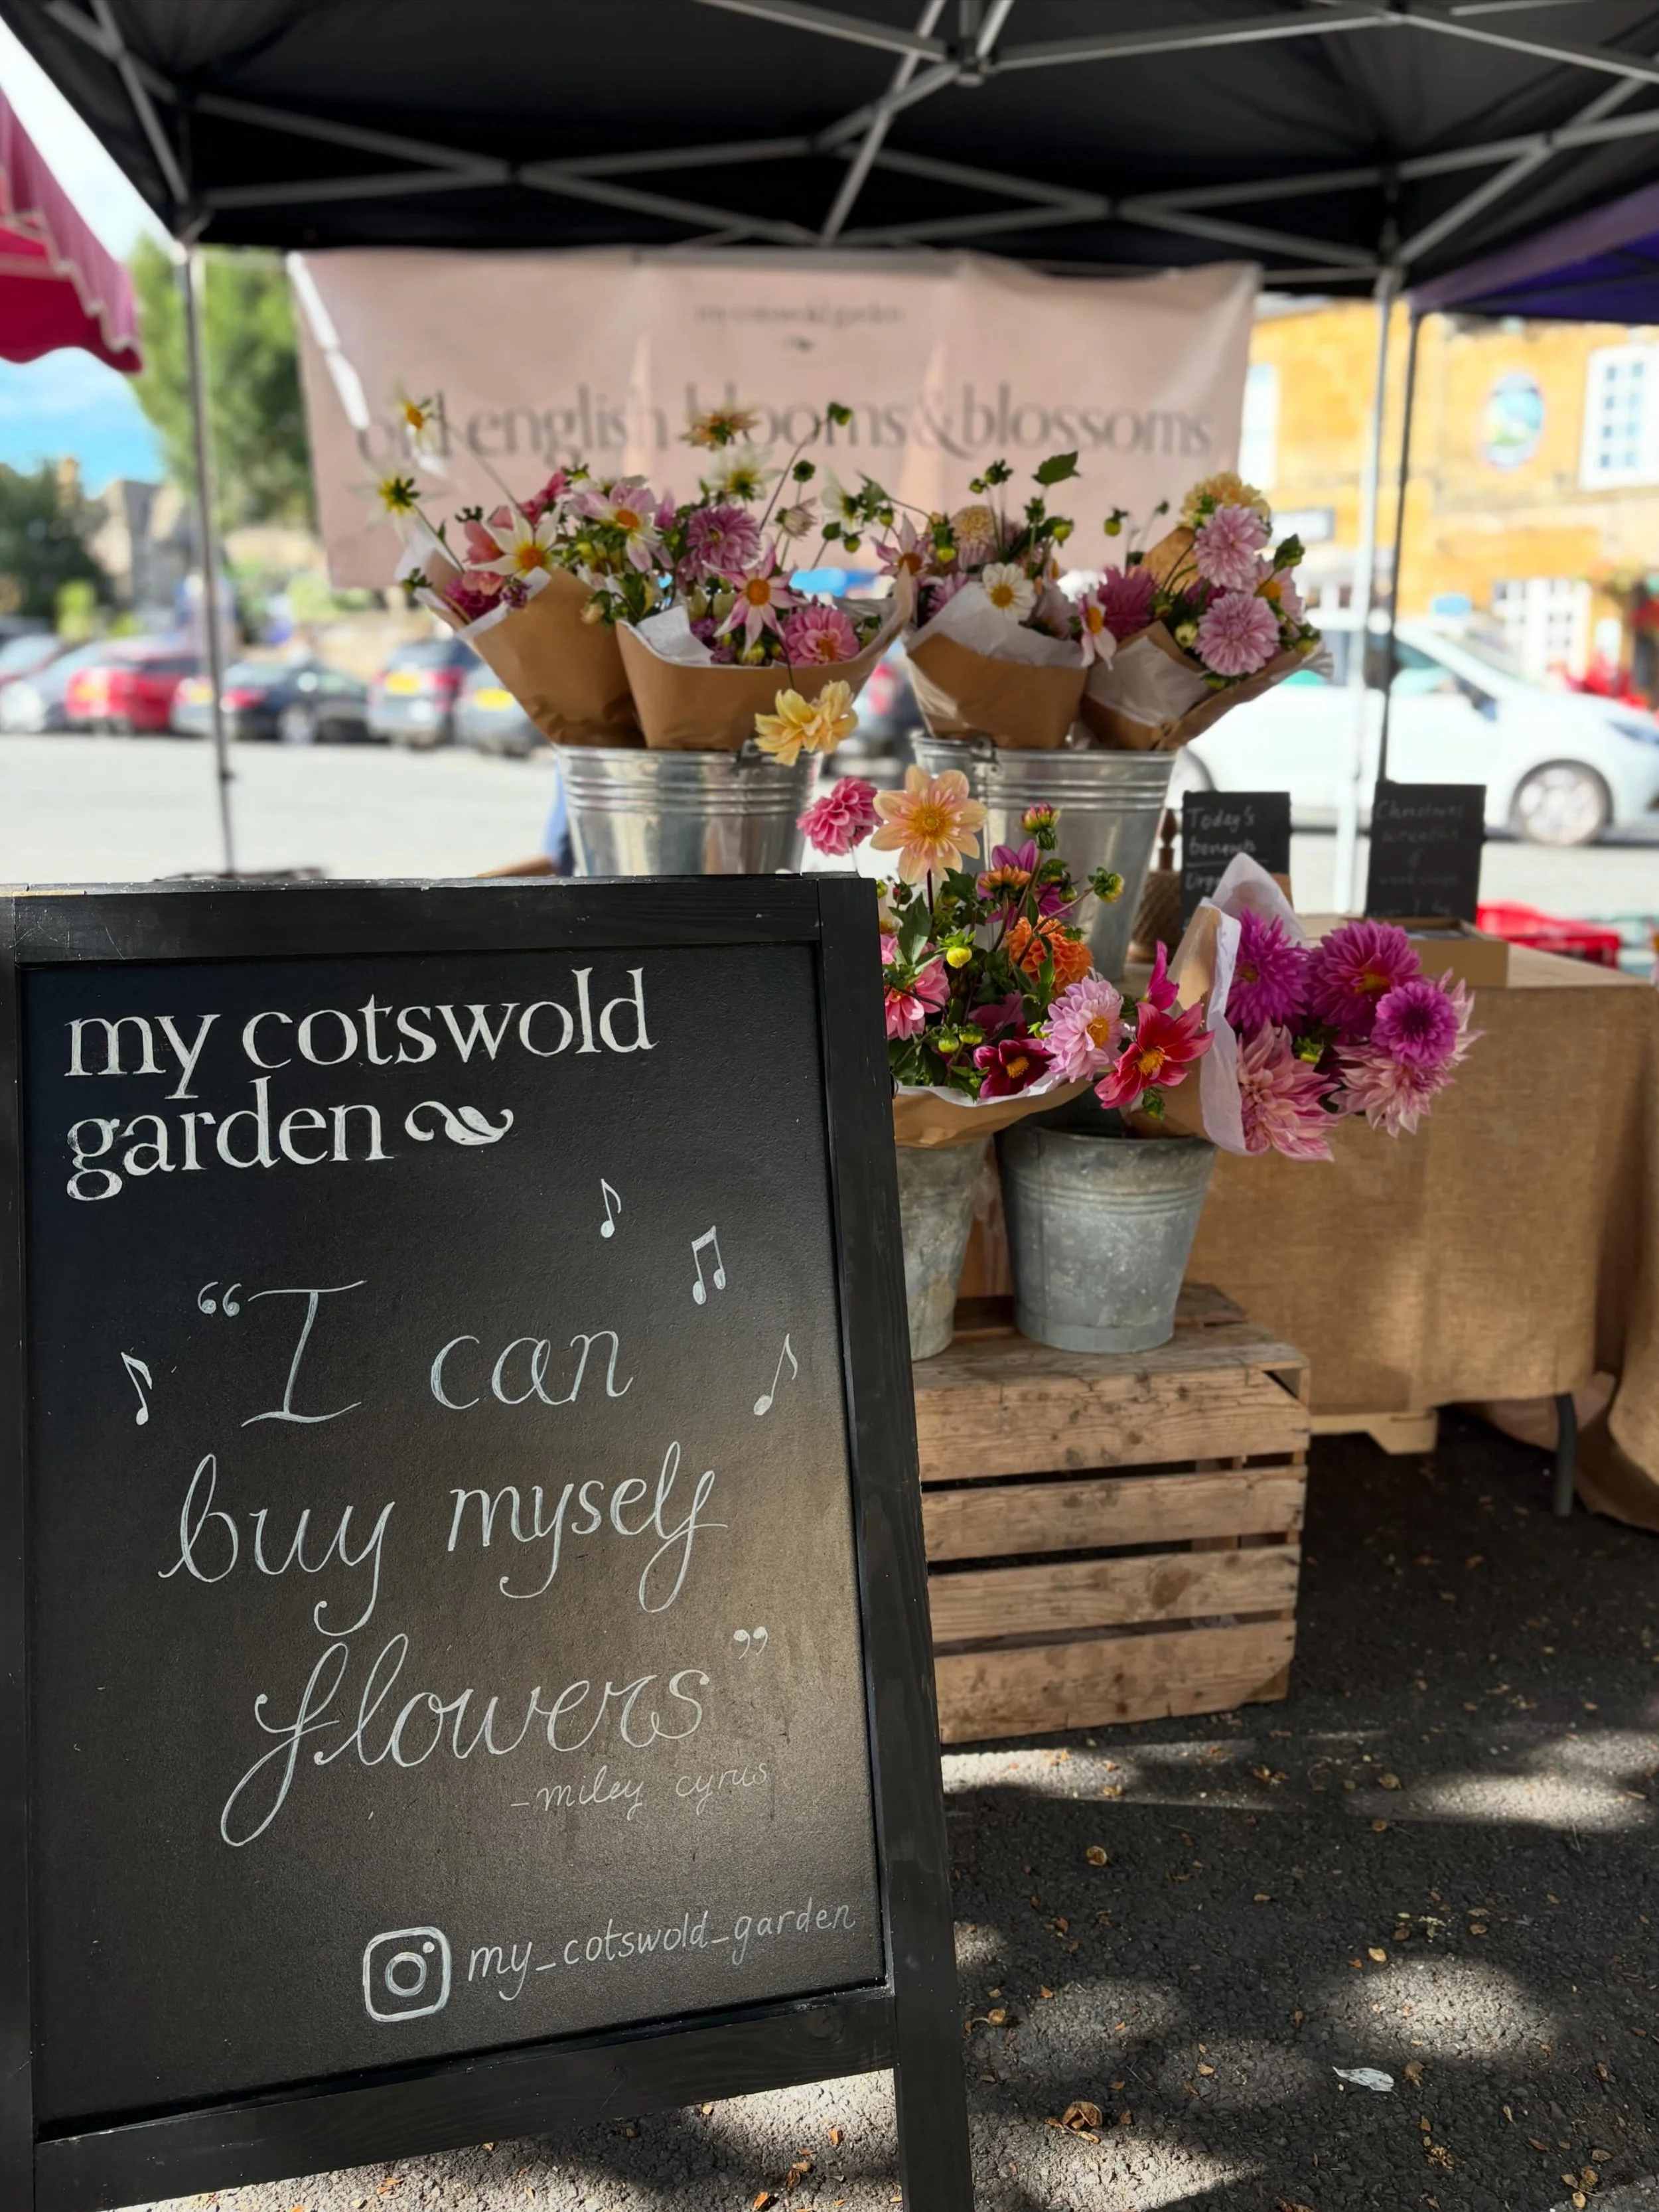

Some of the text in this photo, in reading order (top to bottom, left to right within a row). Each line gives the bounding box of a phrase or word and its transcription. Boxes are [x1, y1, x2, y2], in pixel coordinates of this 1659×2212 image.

[64, 966, 660, 1100] my cotswold
[66, 1076, 396, 1203] garden
[430, 1329, 634, 1410] can
[157, 1441, 729, 1637] buy myself
[676, 1761, 768, 1815] cyrus
[468, 1897, 856, 2001] my_cotswold_garden
